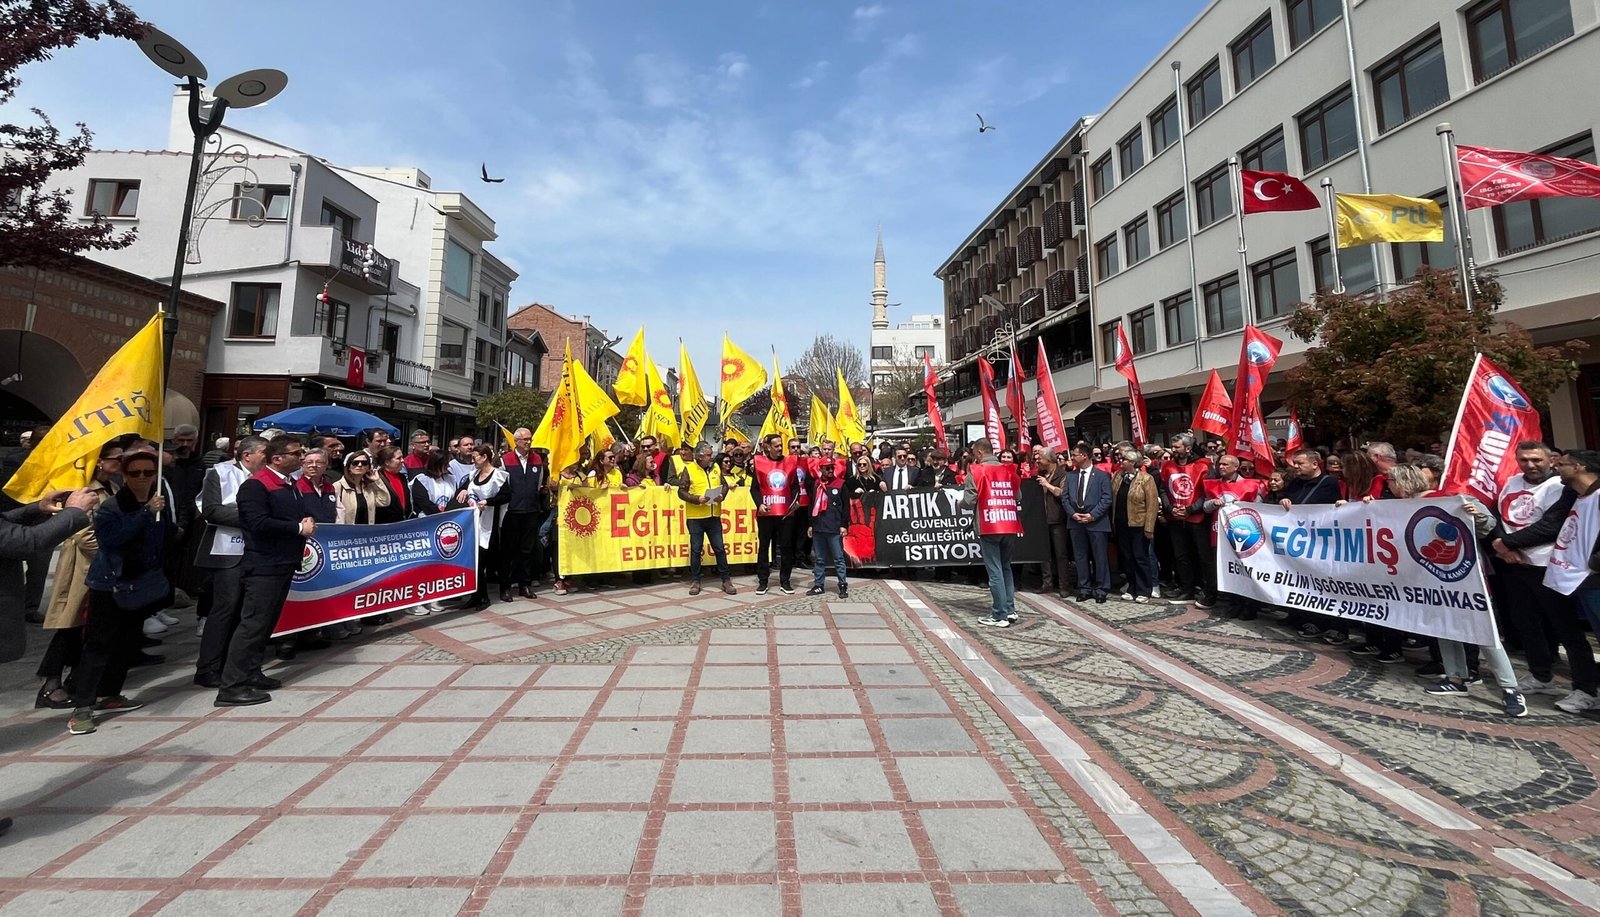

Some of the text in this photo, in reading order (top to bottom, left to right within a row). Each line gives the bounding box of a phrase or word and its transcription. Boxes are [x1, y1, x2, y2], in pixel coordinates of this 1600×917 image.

[1391, 205, 1429, 225] Ptt
[991, 480, 1012, 488] EMEK
[610, 493, 758, 538] EĞİTİ SE
[882, 491, 942, 520] ARTIK
[983, 508, 1017, 524] Eğitim
[328, 530, 430, 548] MEMUR-SEN KONFEDERASYONU
[886, 528, 975, 544] SAĞLIKLI EĞİTİM
[329, 537, 432, 561] EĞİTİM-BİR-SEN
[331, 558, 372, 571] EĞİTİMCİLER
[374, 554, 398, 565] BİRLİĞİ
[399, 548, 433, 561] SENDİKASI
[621, 540, 690, 562] EDİRNE
[905, 542, 982, 561] İSTİYOR
[354, 572, 466, 610] EDİRNE ŞUBESİ
[1256, 571, 1271, 582] ve
[1273, 570, 1310, 590] BİLİM
[1310, 574, 1401, 602] İŞGÖRENLERİ
[1403, 585, 1489, 612] SENDİKAS
[1286, 591, 1390, 621] EDİRNE ŞUBESİ
